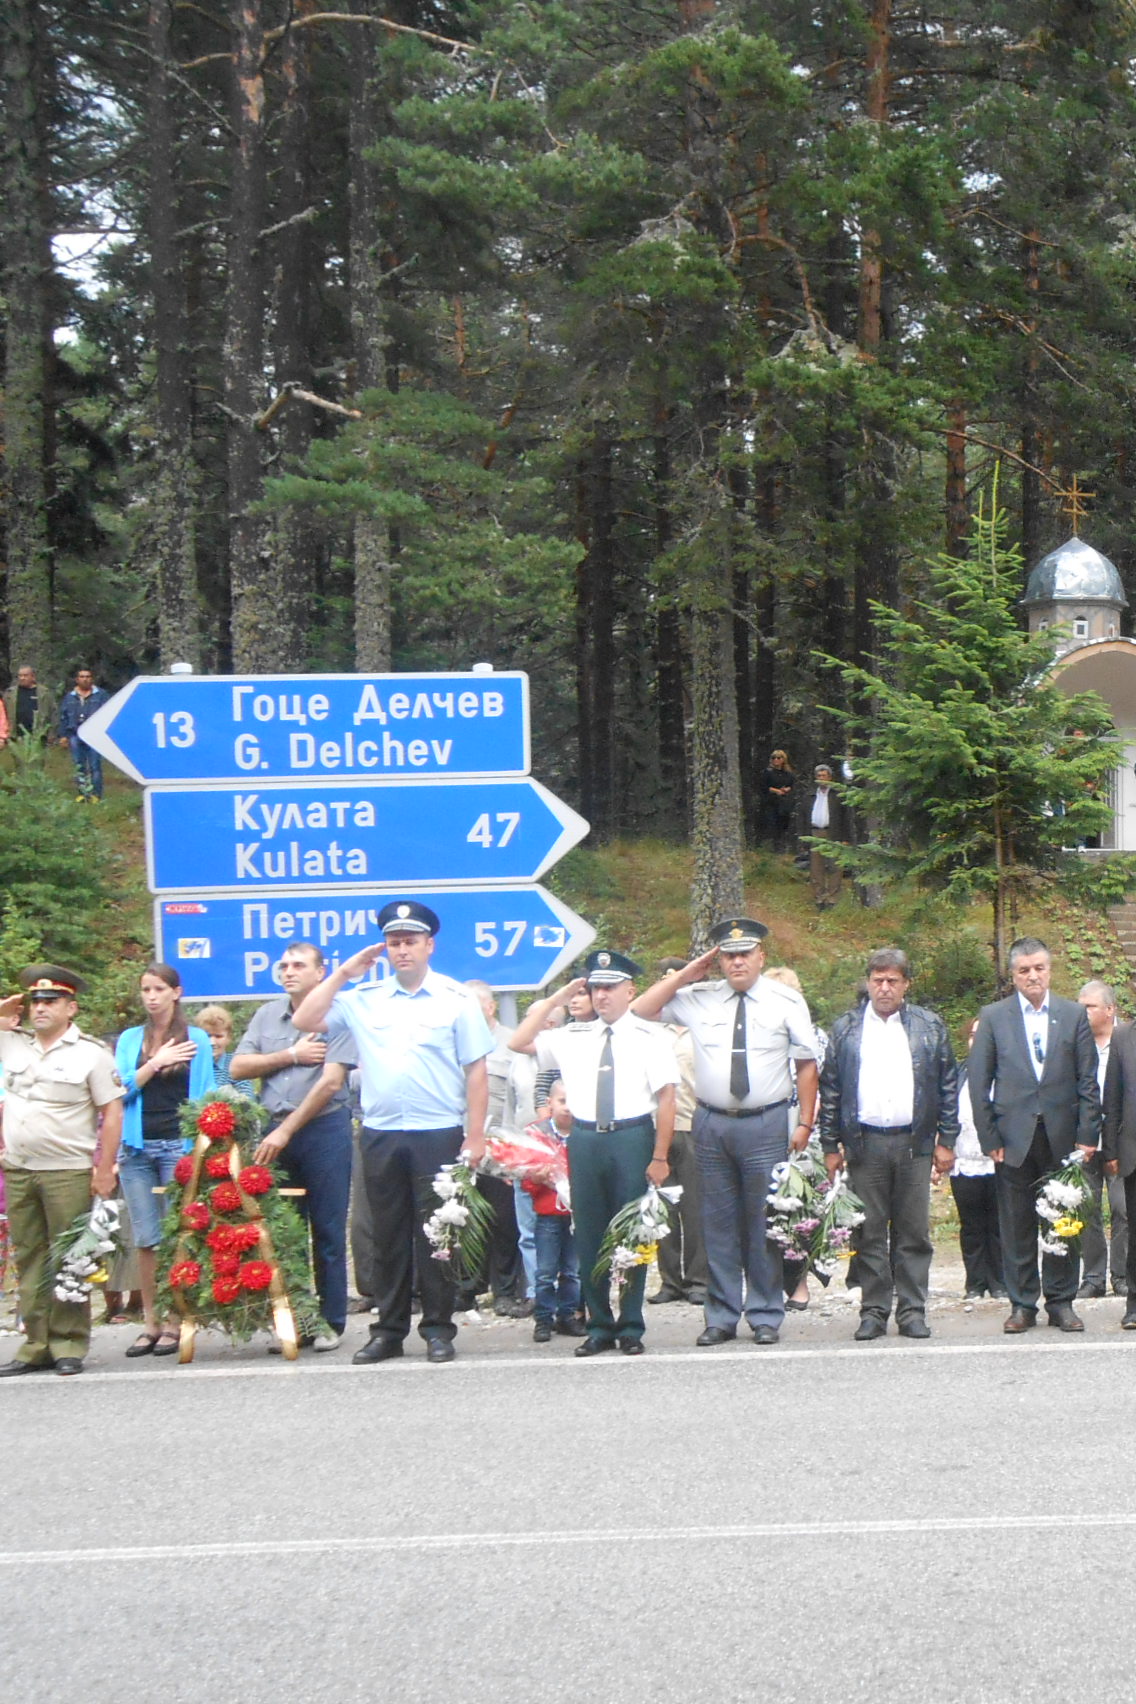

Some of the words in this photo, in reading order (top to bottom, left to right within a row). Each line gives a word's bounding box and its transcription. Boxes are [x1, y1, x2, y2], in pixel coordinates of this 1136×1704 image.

[232, 686, 330, 726] Гоце
[353, 684, 504, 726] Делчев
[152, 712, 196, 749] 13
[234, 733, 269, 770] G.
[289, 731, 453, 769] Delchev
[233, 794, 376, 840] Кулата
[466, 812, 520, 848] 47
[235, 841, 368, 879] Kulata
[474, 920, 528, 958] 57
